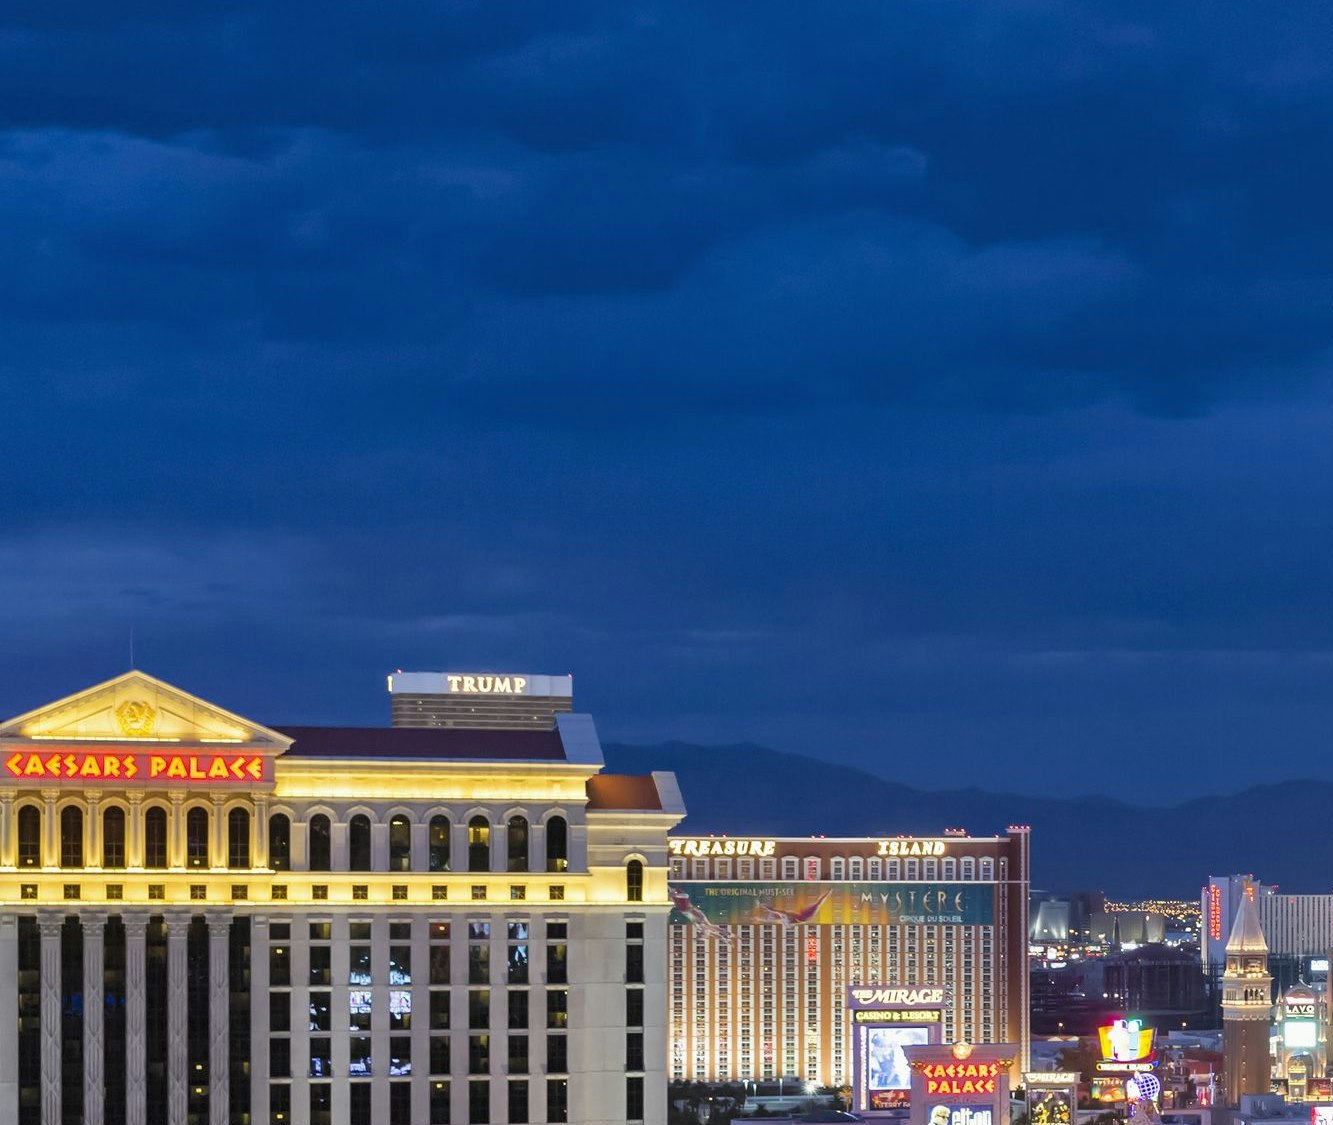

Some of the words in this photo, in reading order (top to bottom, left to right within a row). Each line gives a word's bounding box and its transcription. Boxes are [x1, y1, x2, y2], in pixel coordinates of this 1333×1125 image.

[447, 676, 527, 694] TRUMP
[6, 753, 138, 778] CAESARS
[151, 755, 264, 781] PALACE
[669, 840, 776, 856] TREASURE
[878, 841, 945, 856] ISLAND
[704, 887, 720, 896] THE
[899, 914, 925, 923] CIRQUE
[860, 989, 943, 1005] MIRAGE
[856, 1011, 891, 1020] CASINO
[902, 1011, 940, 1020] RESORT
[1286, 1004, 1315, 1014] LAVO
[923, 1064, 999, 1079] CAESARS
[928, 1080, 996, 1094] PALACE
